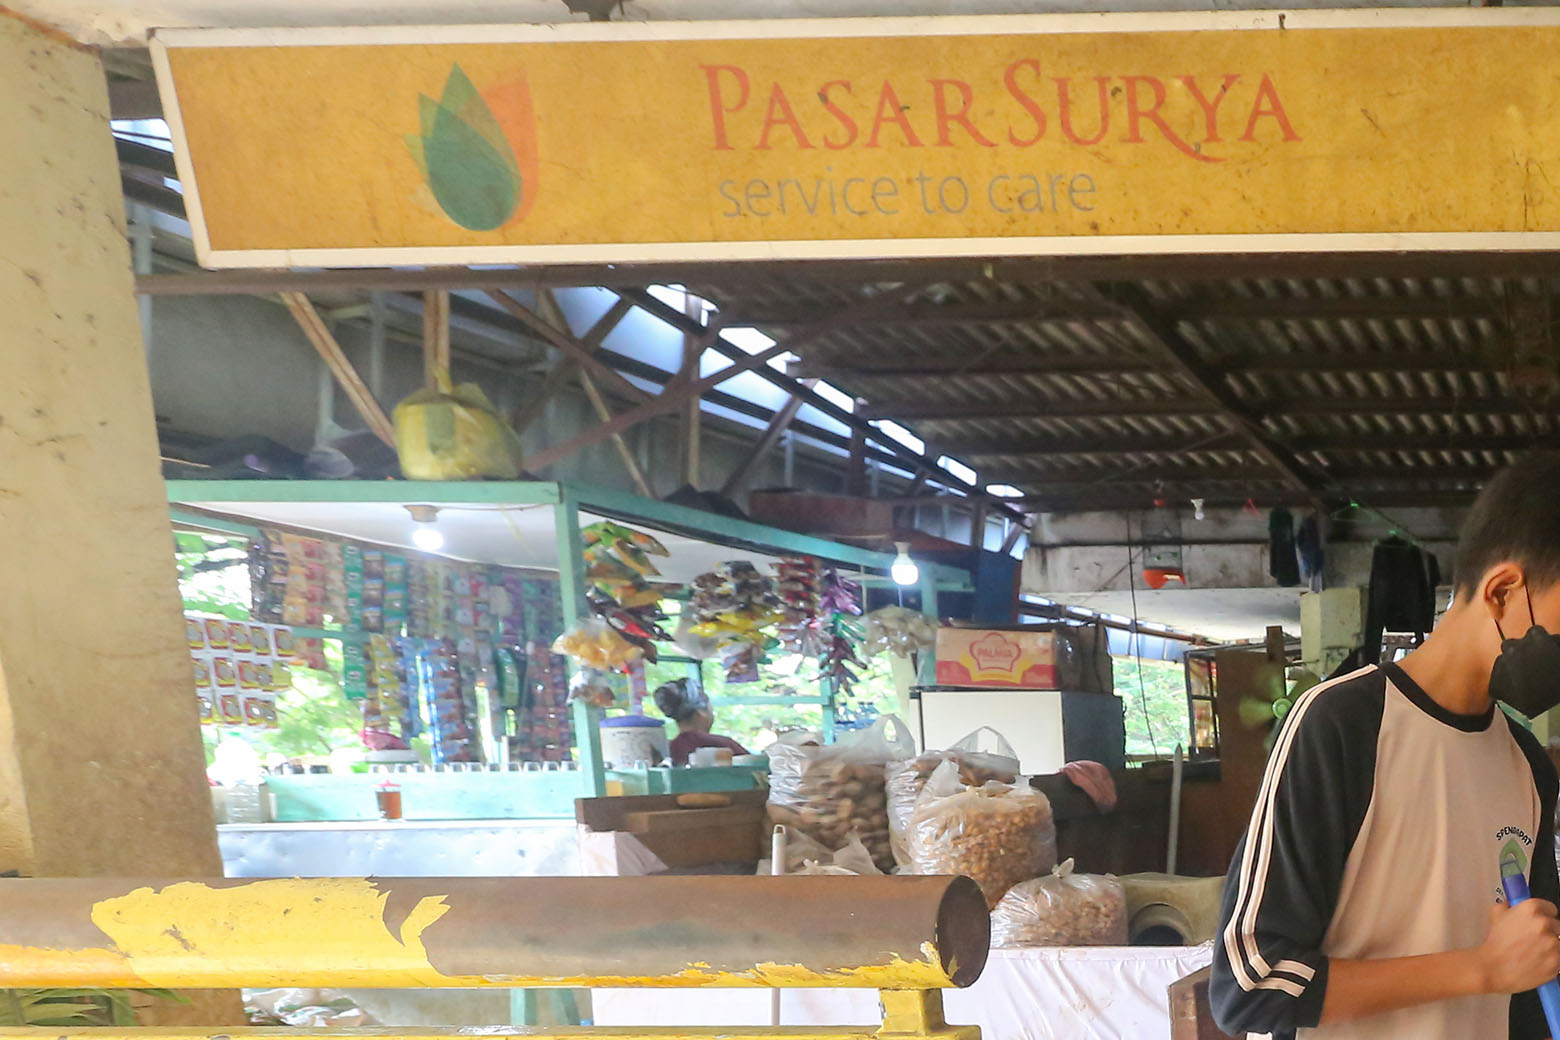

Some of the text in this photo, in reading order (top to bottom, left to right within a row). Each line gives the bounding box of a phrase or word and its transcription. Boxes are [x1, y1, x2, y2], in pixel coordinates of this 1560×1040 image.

[719, 166, 1097, 218] service to care
